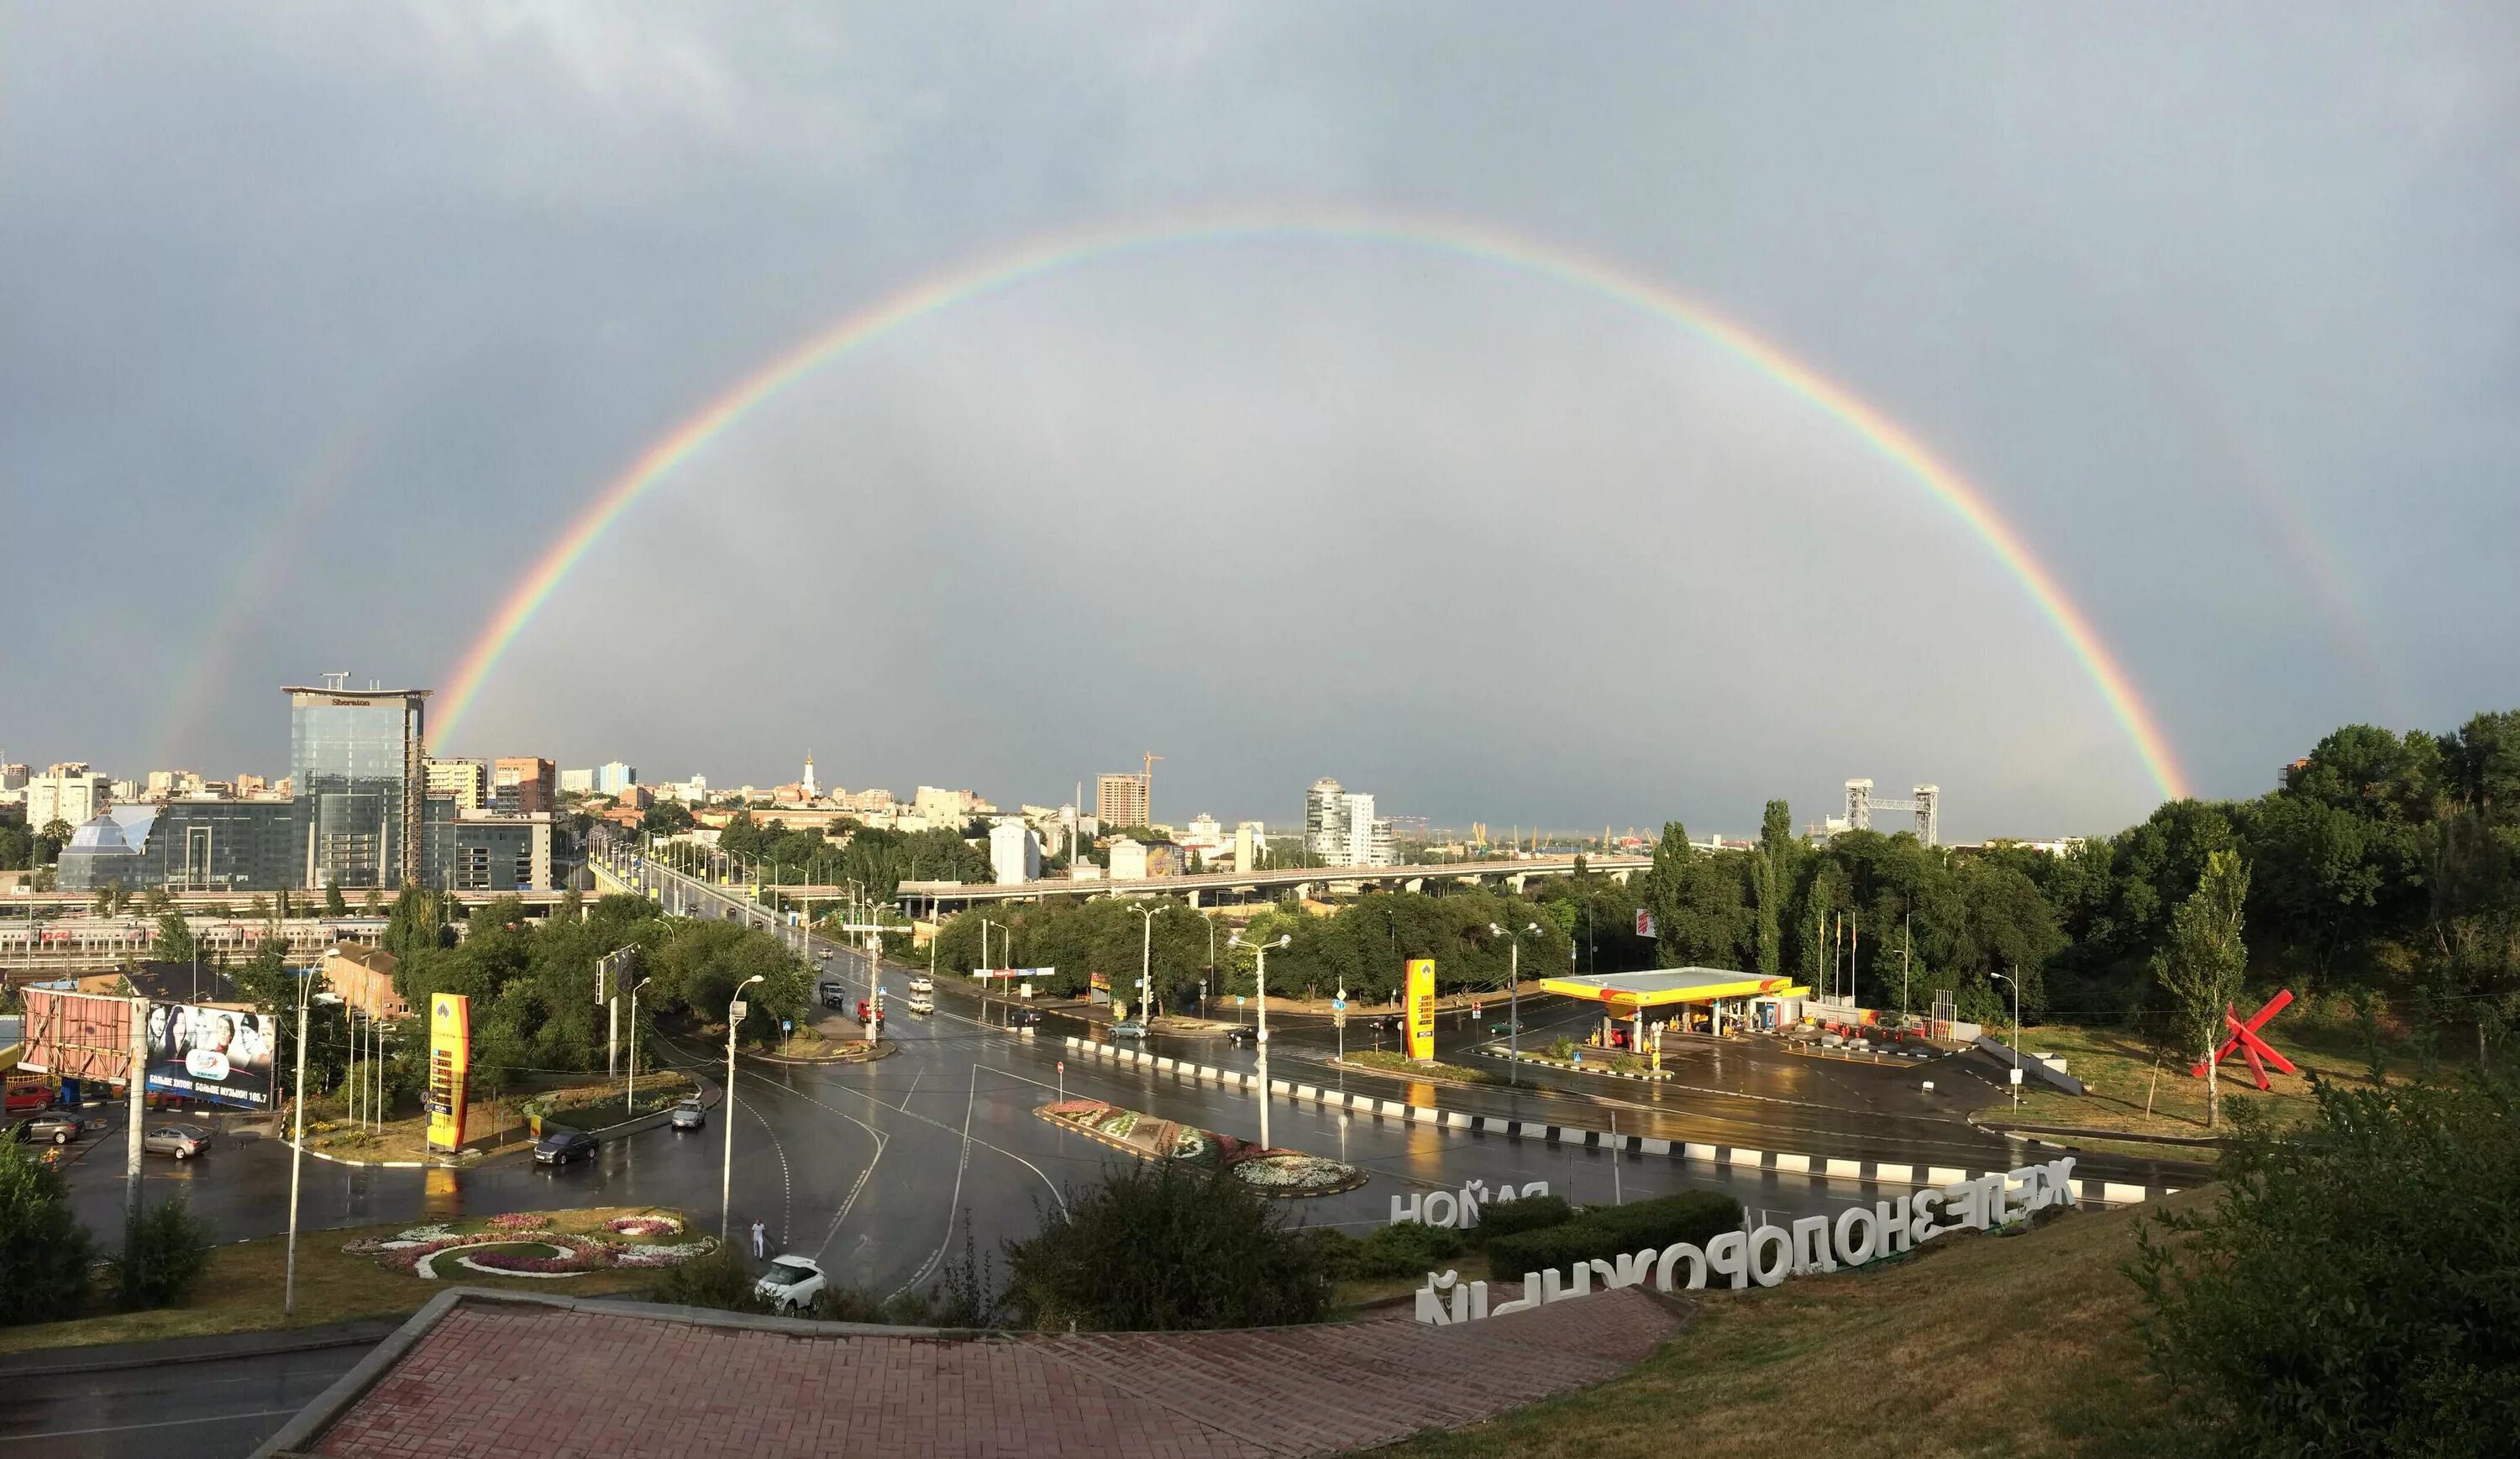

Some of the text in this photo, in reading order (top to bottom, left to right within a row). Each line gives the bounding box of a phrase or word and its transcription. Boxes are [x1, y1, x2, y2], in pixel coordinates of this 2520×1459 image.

[332, 698, 370, 706] Sheraton
[150, 1074, 173, 1087] БОЛЬШЕ
[195, 1082, 220, 1095] БОЛЬШЕ
